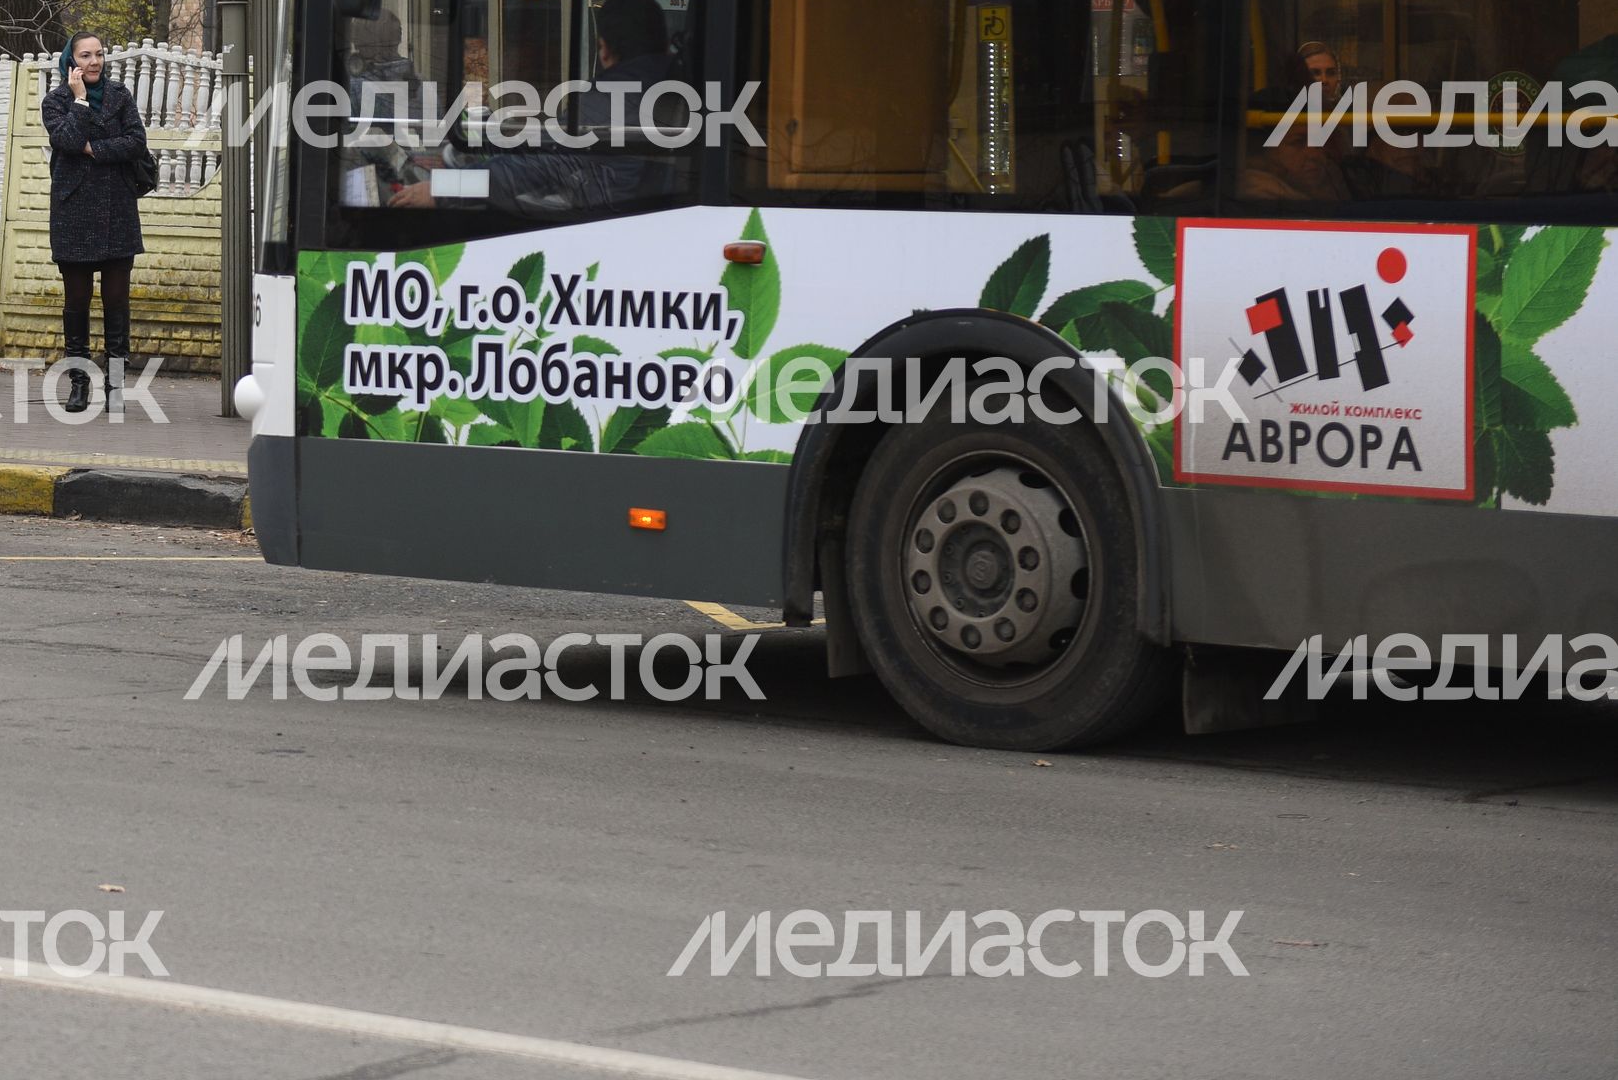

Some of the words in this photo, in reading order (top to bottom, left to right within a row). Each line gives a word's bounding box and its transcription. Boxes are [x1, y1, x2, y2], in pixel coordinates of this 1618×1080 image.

[350, 268, 444, 329] МО,
[459, 285, 534, 324] г.о.
[550, 273, 737, 339] Химки,
[348, 349, 459, 404] мкр.
[471, 342, 734, 404] Лобаново
[1290, 401, 1340, 416] жилой
[1344, 406, 1423, 420] комплекс
[1222, 419, 1422, 472] АВРОРА
